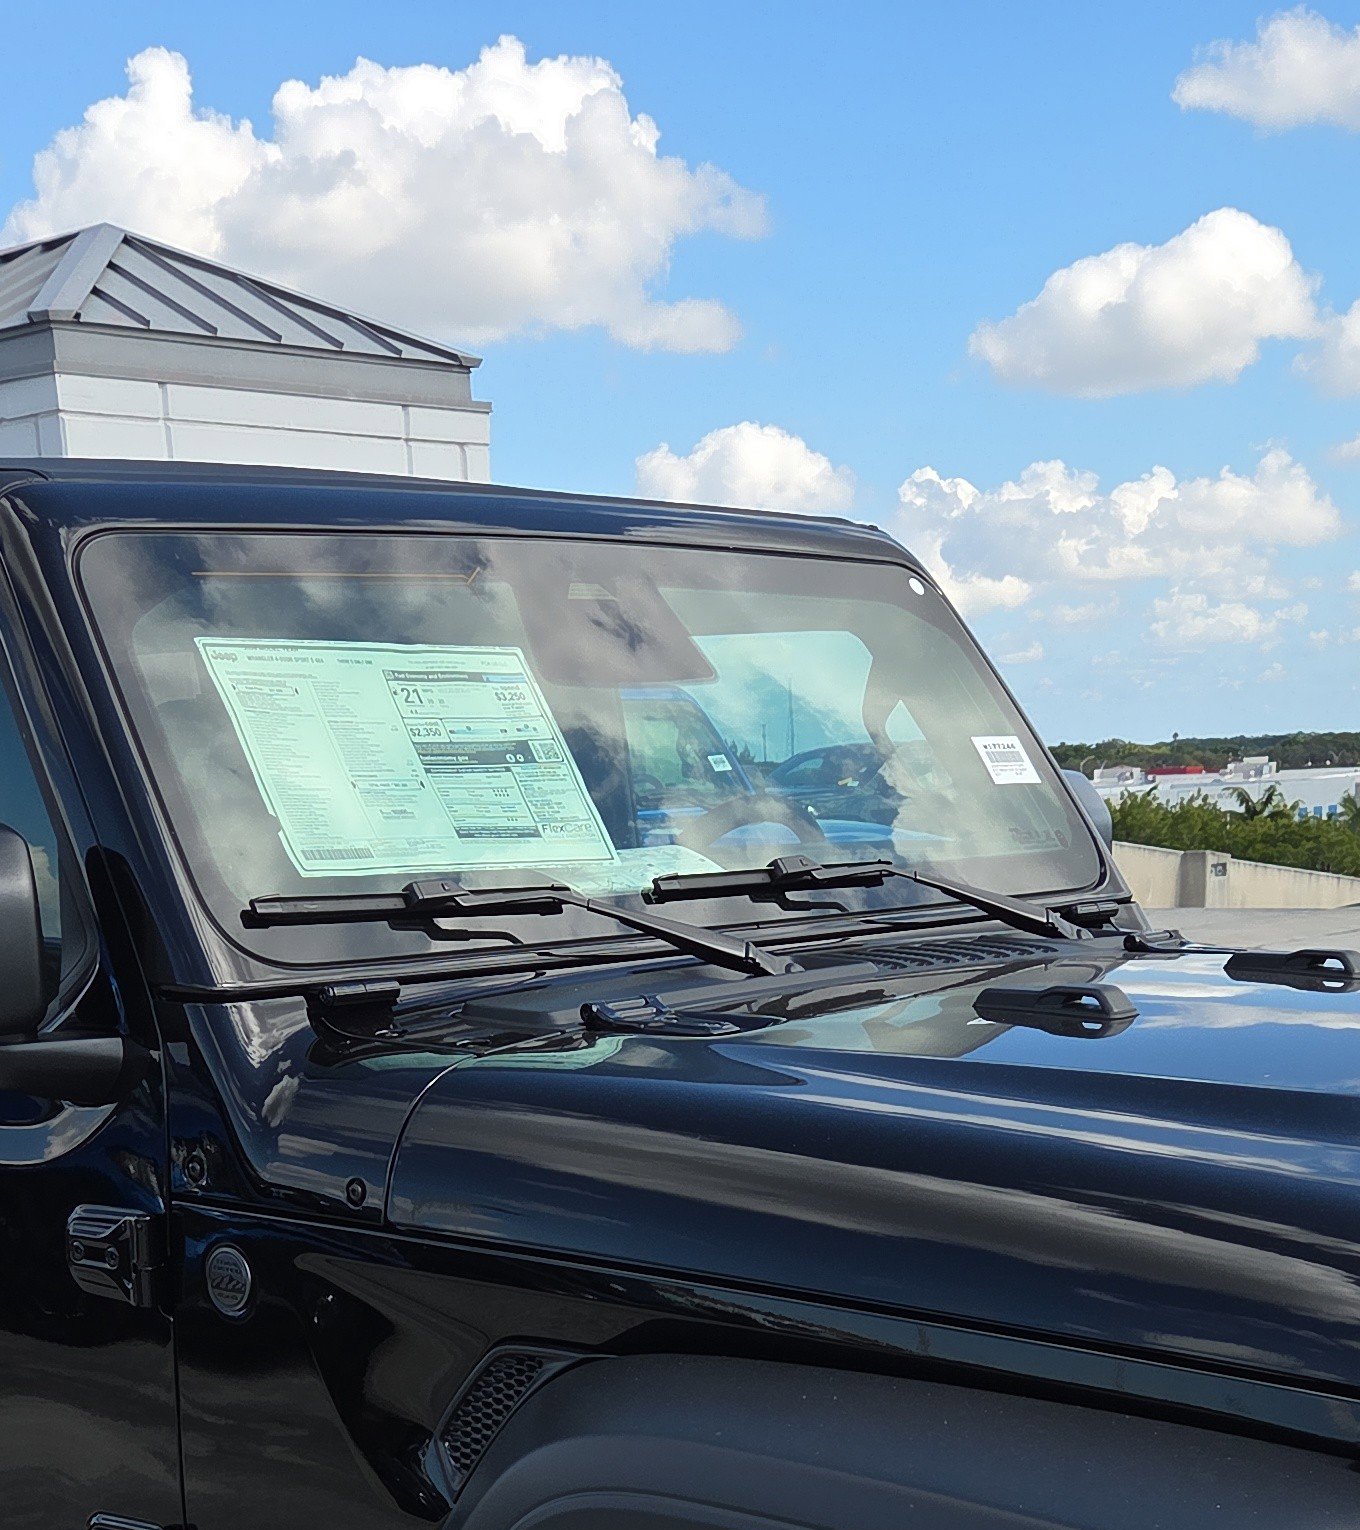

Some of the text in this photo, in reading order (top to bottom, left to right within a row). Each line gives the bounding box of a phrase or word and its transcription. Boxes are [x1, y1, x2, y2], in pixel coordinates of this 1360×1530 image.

[211, 650, 238, 663] Jeep
[401, 688, 423, 704] 21
[542, 822, 592, 833] FlexCare
